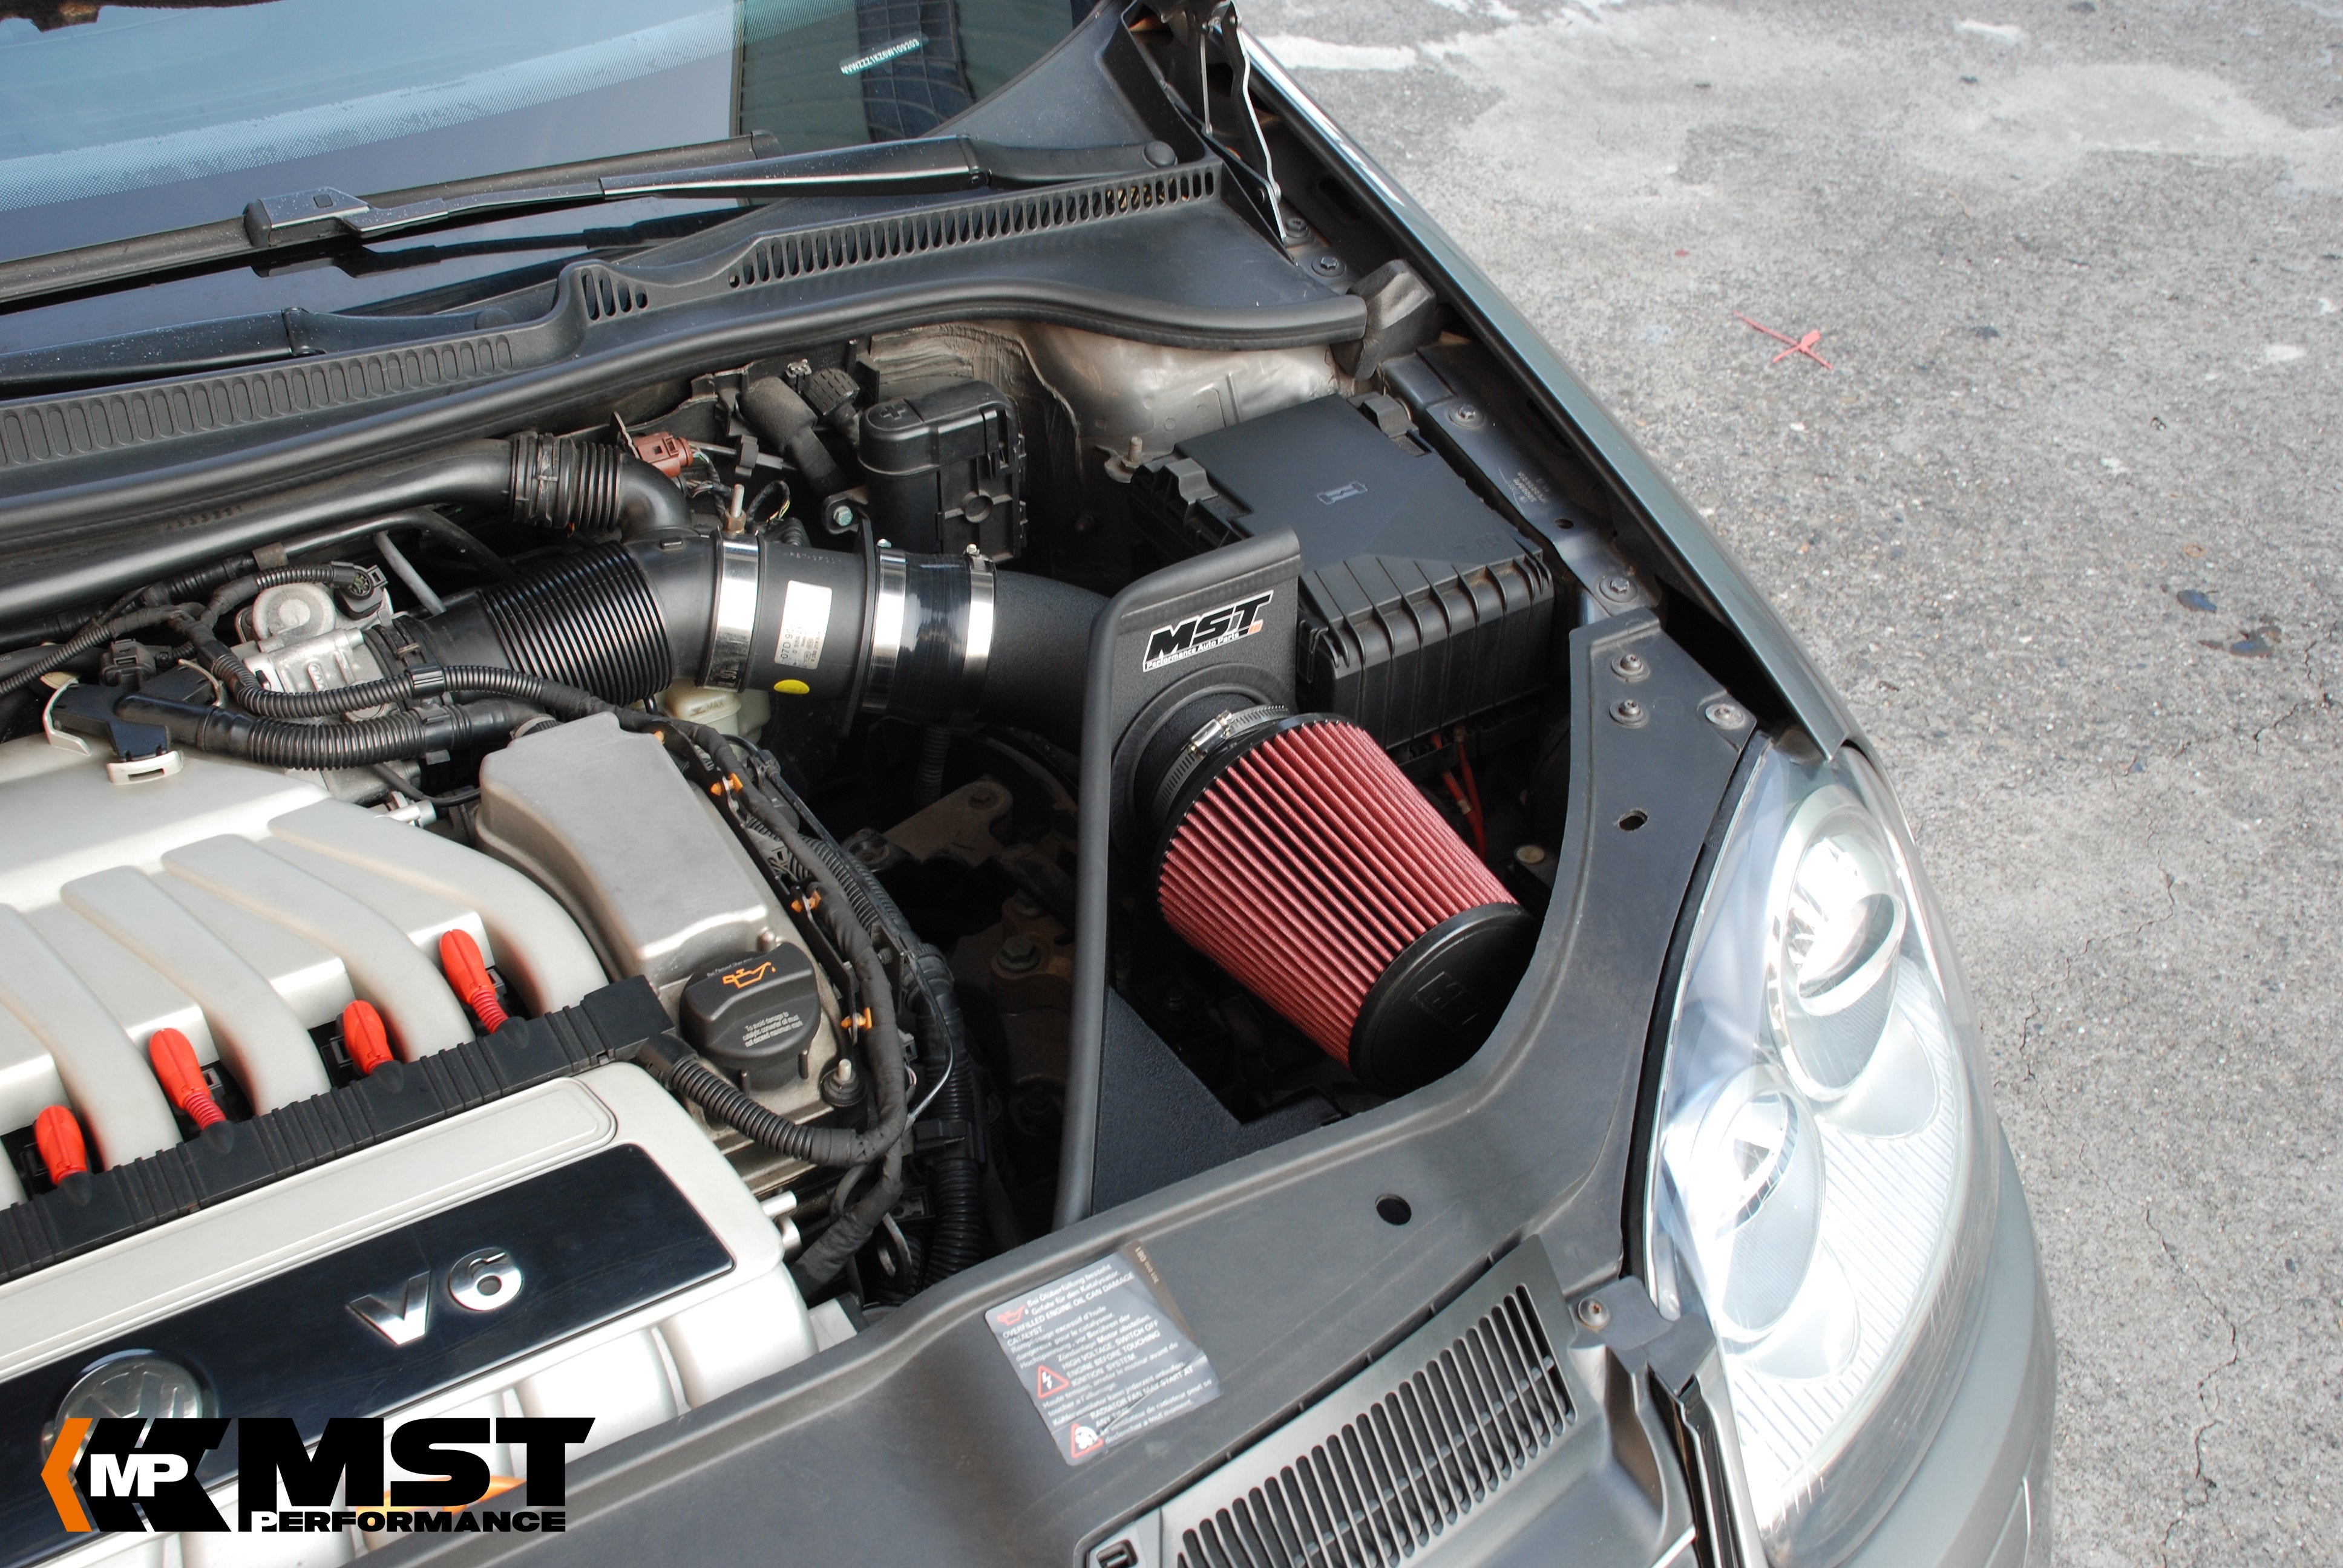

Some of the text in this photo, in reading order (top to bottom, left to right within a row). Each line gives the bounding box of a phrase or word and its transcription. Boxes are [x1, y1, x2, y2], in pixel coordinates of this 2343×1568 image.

[1145, 592, 1273, 661] MST
[1146, 633, 1240, 670] Performance Auto Parts
[707, 699, 724, 710] MAX
[347, 1246, 523, 1347] V6
[1002, 1271, 1135, 1339] OVERFILLED ENGINE OIL CAN DAMAGE
[1061, 1356, 1081, 1370] HIGH
[1114, 1327, 1145, 1345] SWITCH
[1144, 1319, 1159, 1331] OFF
[1066, 1330, 1161, 1378] ENGINE BEFORE TOUCHING
[1096, 1330, 1118, 1344] Motor
[1070, 1367, 1104, 1387] IGNITION
[1089, 1397, 1127, 1419] RADIATOR
[1127, 1390, 1144, 1402] FAN
[1182, 1366, 1194, 1376] AT
[1094, 1415, 1112, 1428] ANY
